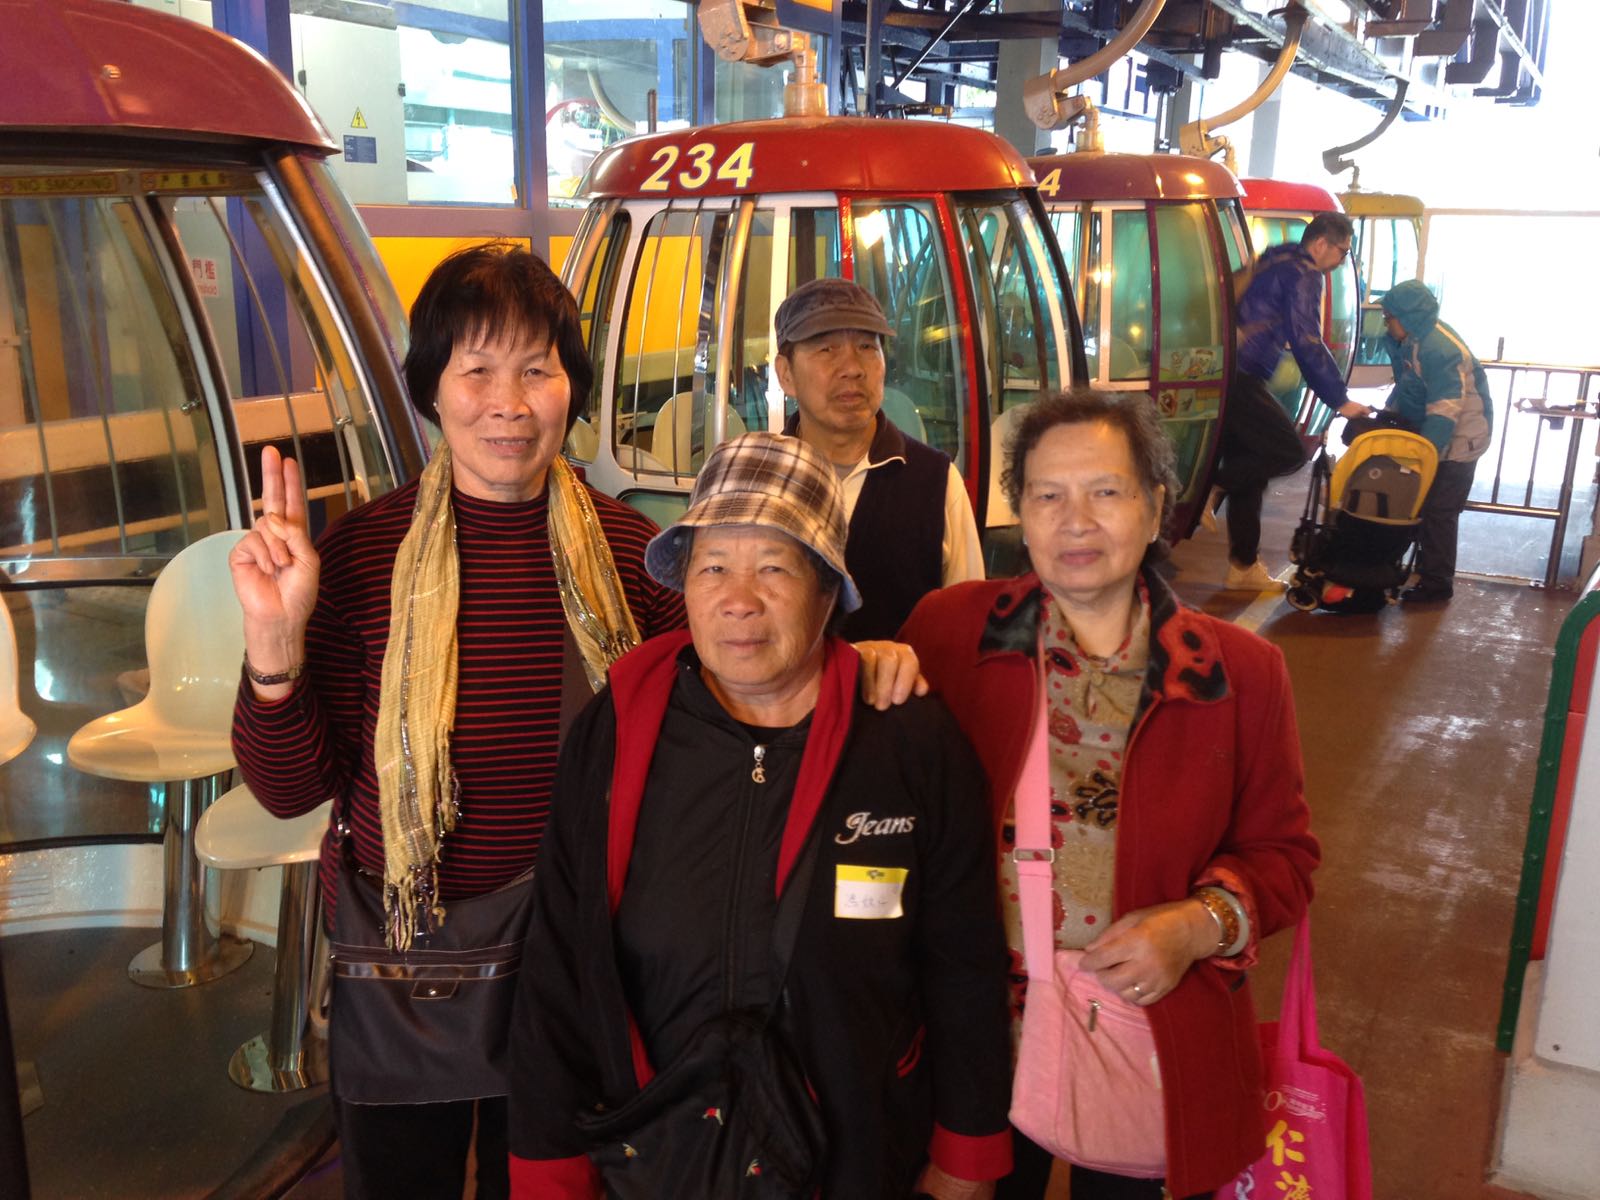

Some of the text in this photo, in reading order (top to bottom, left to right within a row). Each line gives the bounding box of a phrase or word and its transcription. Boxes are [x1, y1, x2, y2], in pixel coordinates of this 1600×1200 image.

[639, 142, 755, 191] 234
[1037, 168, 1062, 197] 4
[835, 812, 916, 845] Jeans
